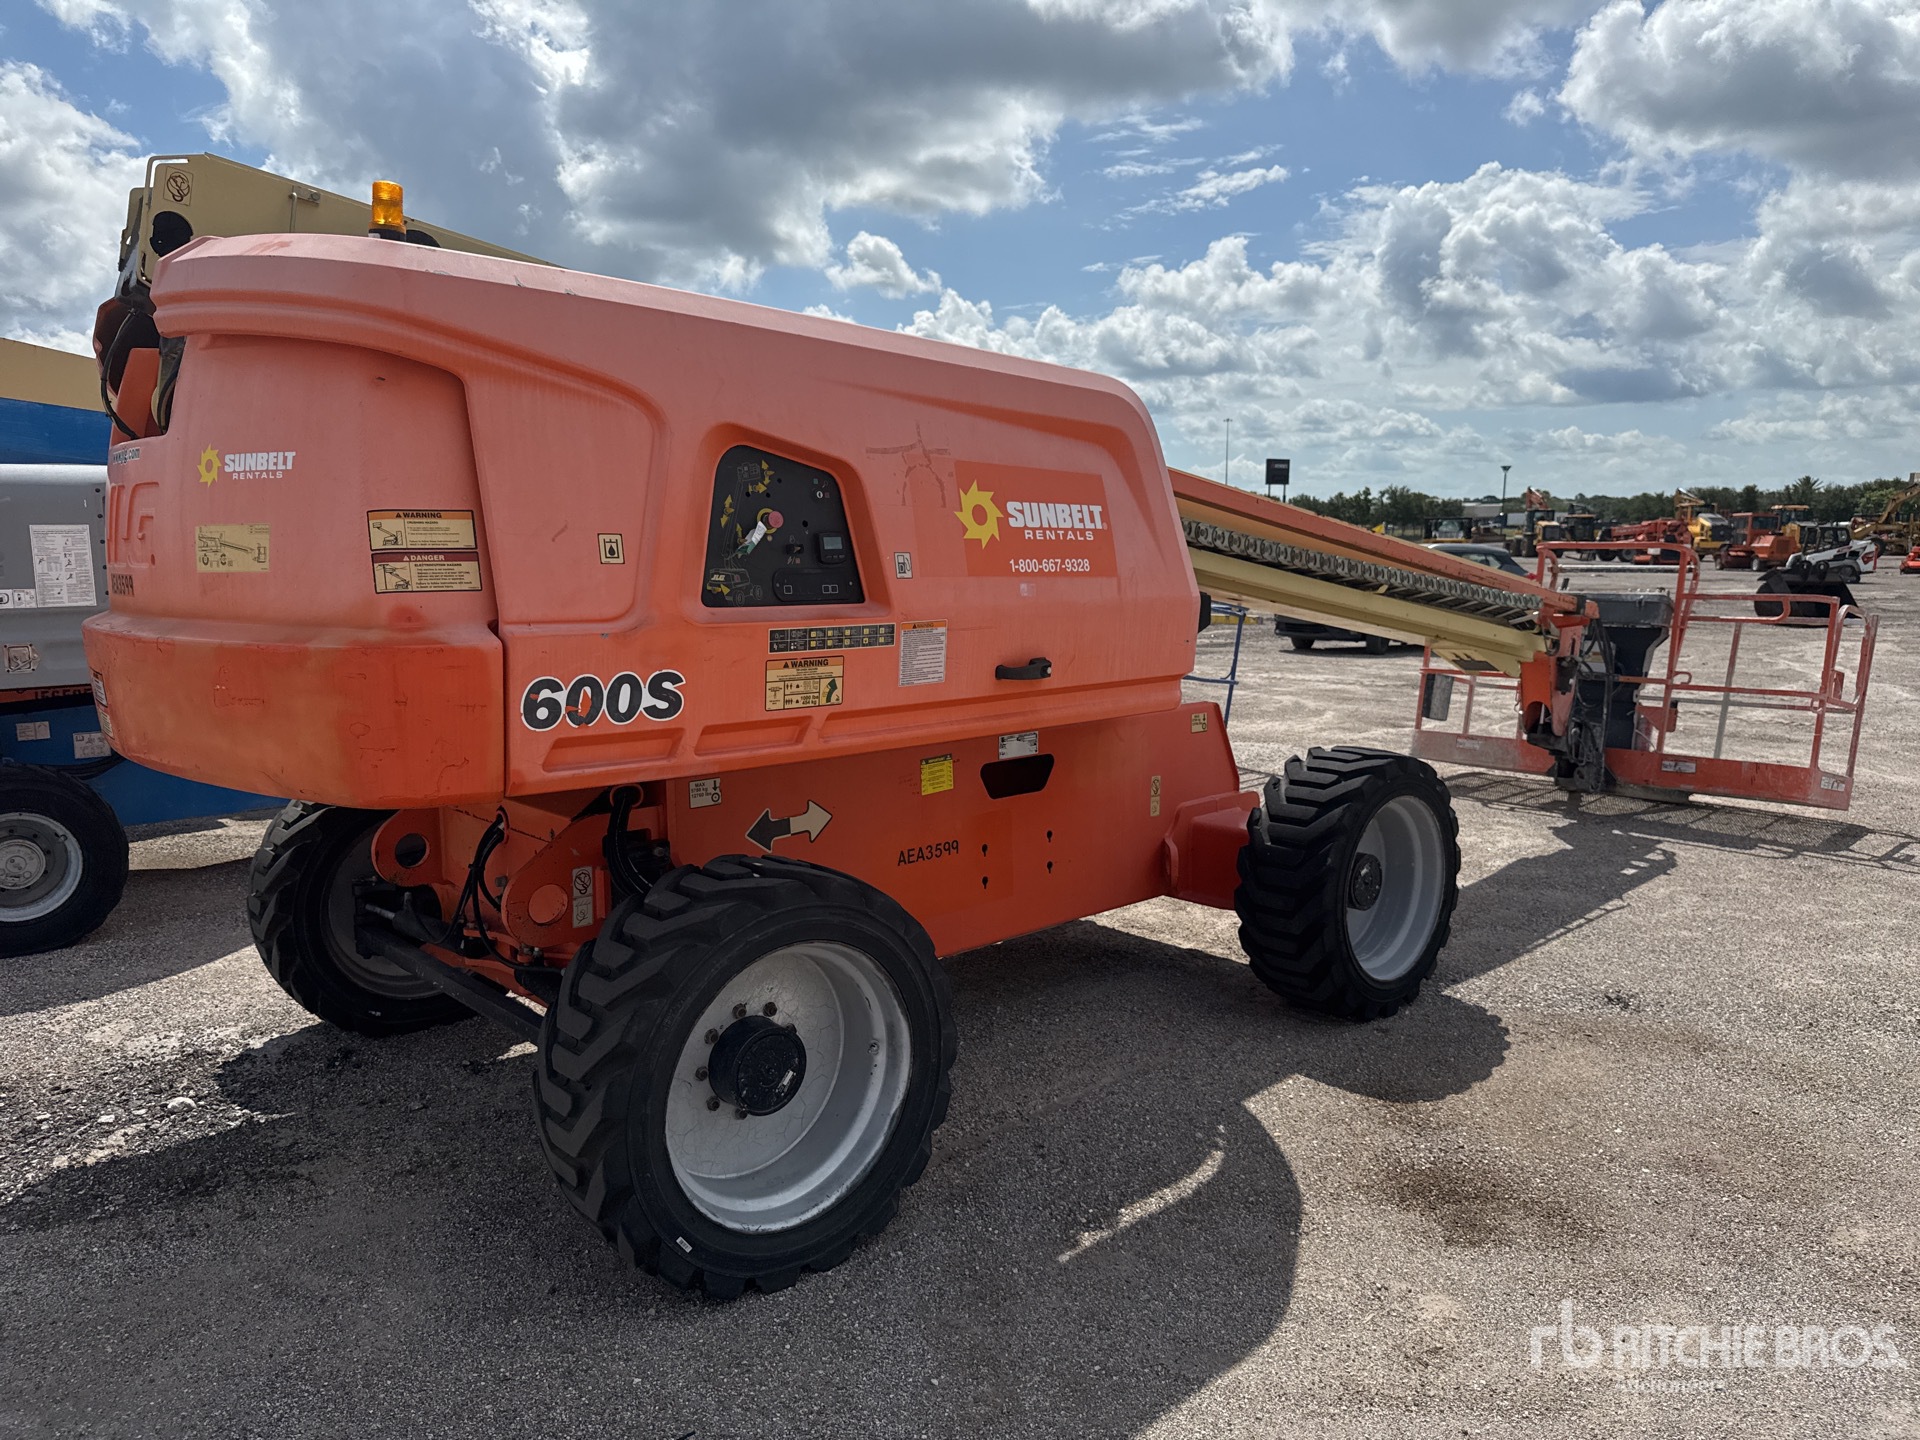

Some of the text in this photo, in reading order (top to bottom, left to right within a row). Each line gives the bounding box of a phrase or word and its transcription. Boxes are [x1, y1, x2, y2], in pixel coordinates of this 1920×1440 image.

[224, 451, 296, 472] SUNBELT
[232, 471, 283, 480] RENTALS
[1006, 501, 1103, 530] SUNBELT
[1024, 529, 1094, 541] RENTALS
[1009, 558, 1090, 573] 1-800-667-9328
[790, 659, 829, 668] WARNING
[520, 669, 687, 732] 600S
[897, 839, 959, 866] AEA3599
